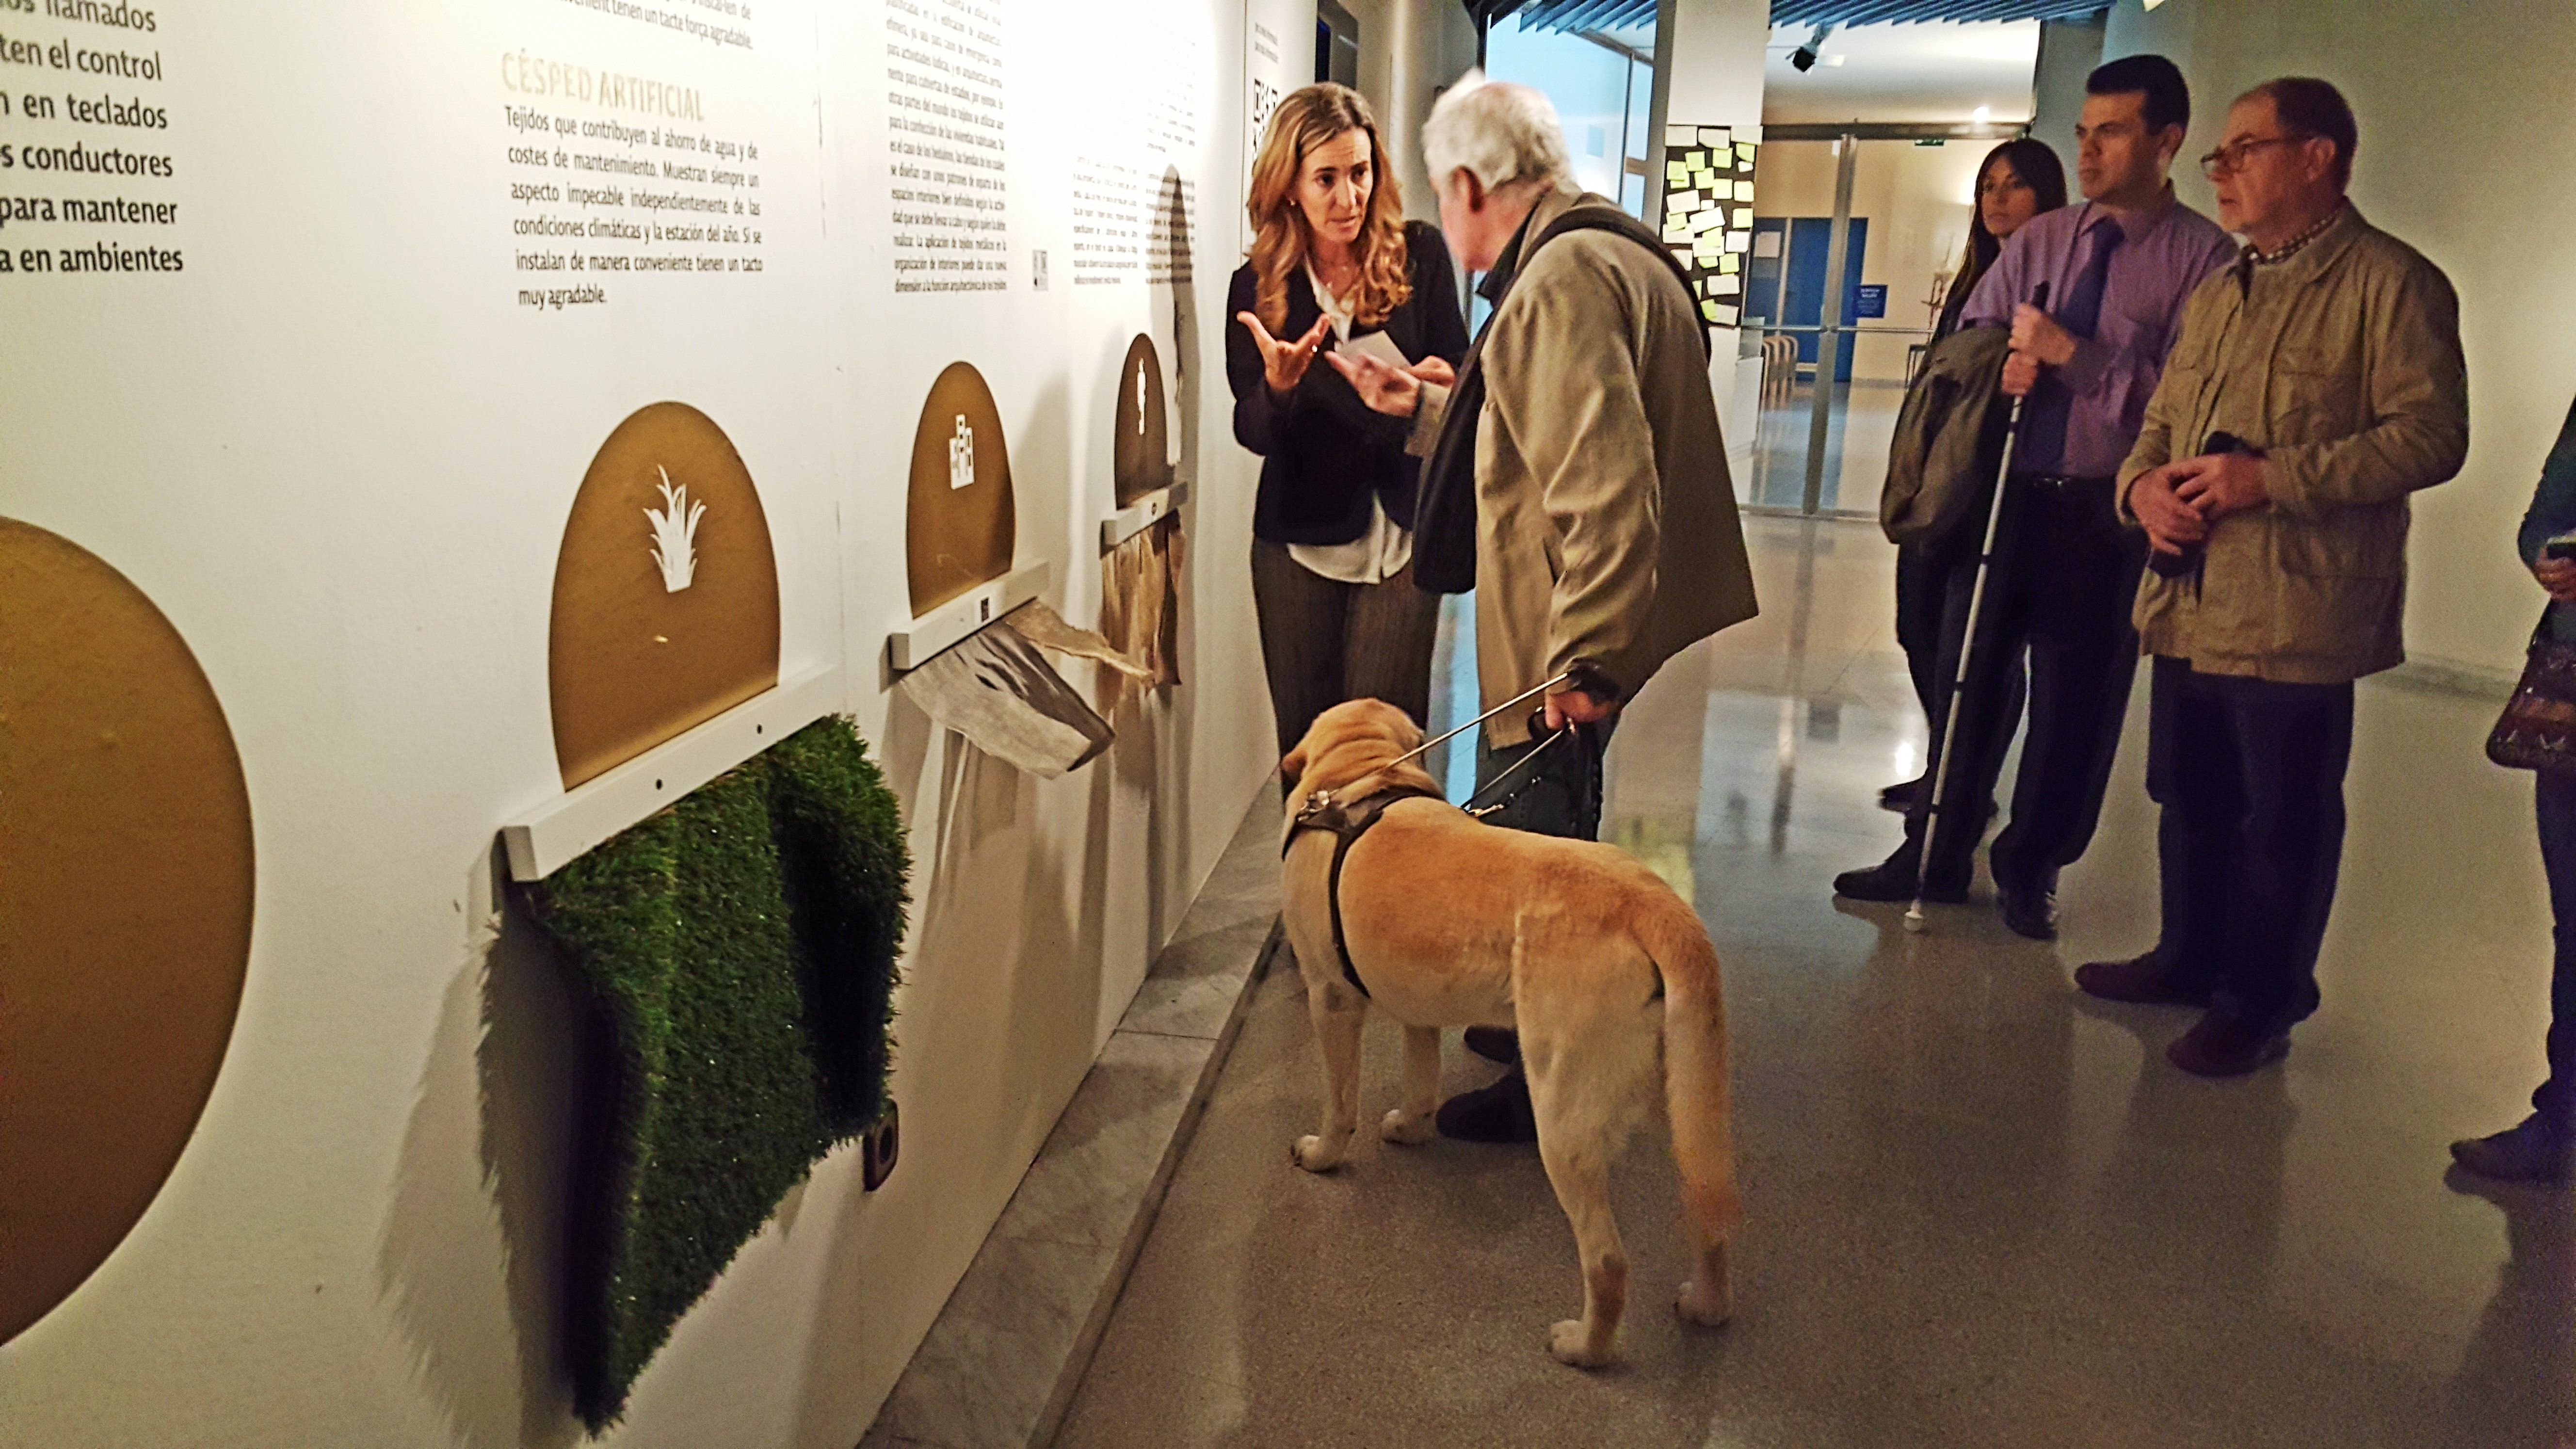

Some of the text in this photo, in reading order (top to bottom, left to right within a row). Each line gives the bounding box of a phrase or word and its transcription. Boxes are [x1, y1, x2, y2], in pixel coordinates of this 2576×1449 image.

[645, 9, 658, 24] un
[48, 38, 70, 70] el
[77, 49, 161, 80] control
[501, 48, 705, 122] CÉSPED ARTIFICIAL
[23, 94, 55, 119] en
[66, 94, 167, 129] teclados
[504, 105, 758, 163] Tejidos que contribuyen al ahorro de agua y de
[22, 141, 173, 177] conductores
[508, 146, 548, 166] costes
[554, 146, 568, 169] de
[663, 161, 707, 182] Muestran
[711, 166, 745, 190] siempre
[63, 197, 177, 224] mantener
[512, 183, 559, 205] aspecto
[567, 182, 624, 209] impecable
[630, 188, 727, 214] independientemente
[734, 197, 744, 215] de
[514, 215, 585, 237] condiciones
[588, 217, 641, 240] climáticas
[644, 226, 650, 245] y
[653, 221, 663, 241] la
[665, 224, 704, 241] estación
[707, 224, 720, 242] del
[20, 250, 52, 273] en
[60, 242, 183, 272] ambientes
[516, 249, 565, 271] instalan
[571, 250, 584, 271] de
[590, 256, 630, 271] manera
[634, 253, 693, 272] conveniente
[696, 253, 724, 272] tienen
[728, 258, 739, 272] un
[519, 284, 606, 311] muy agradable.
